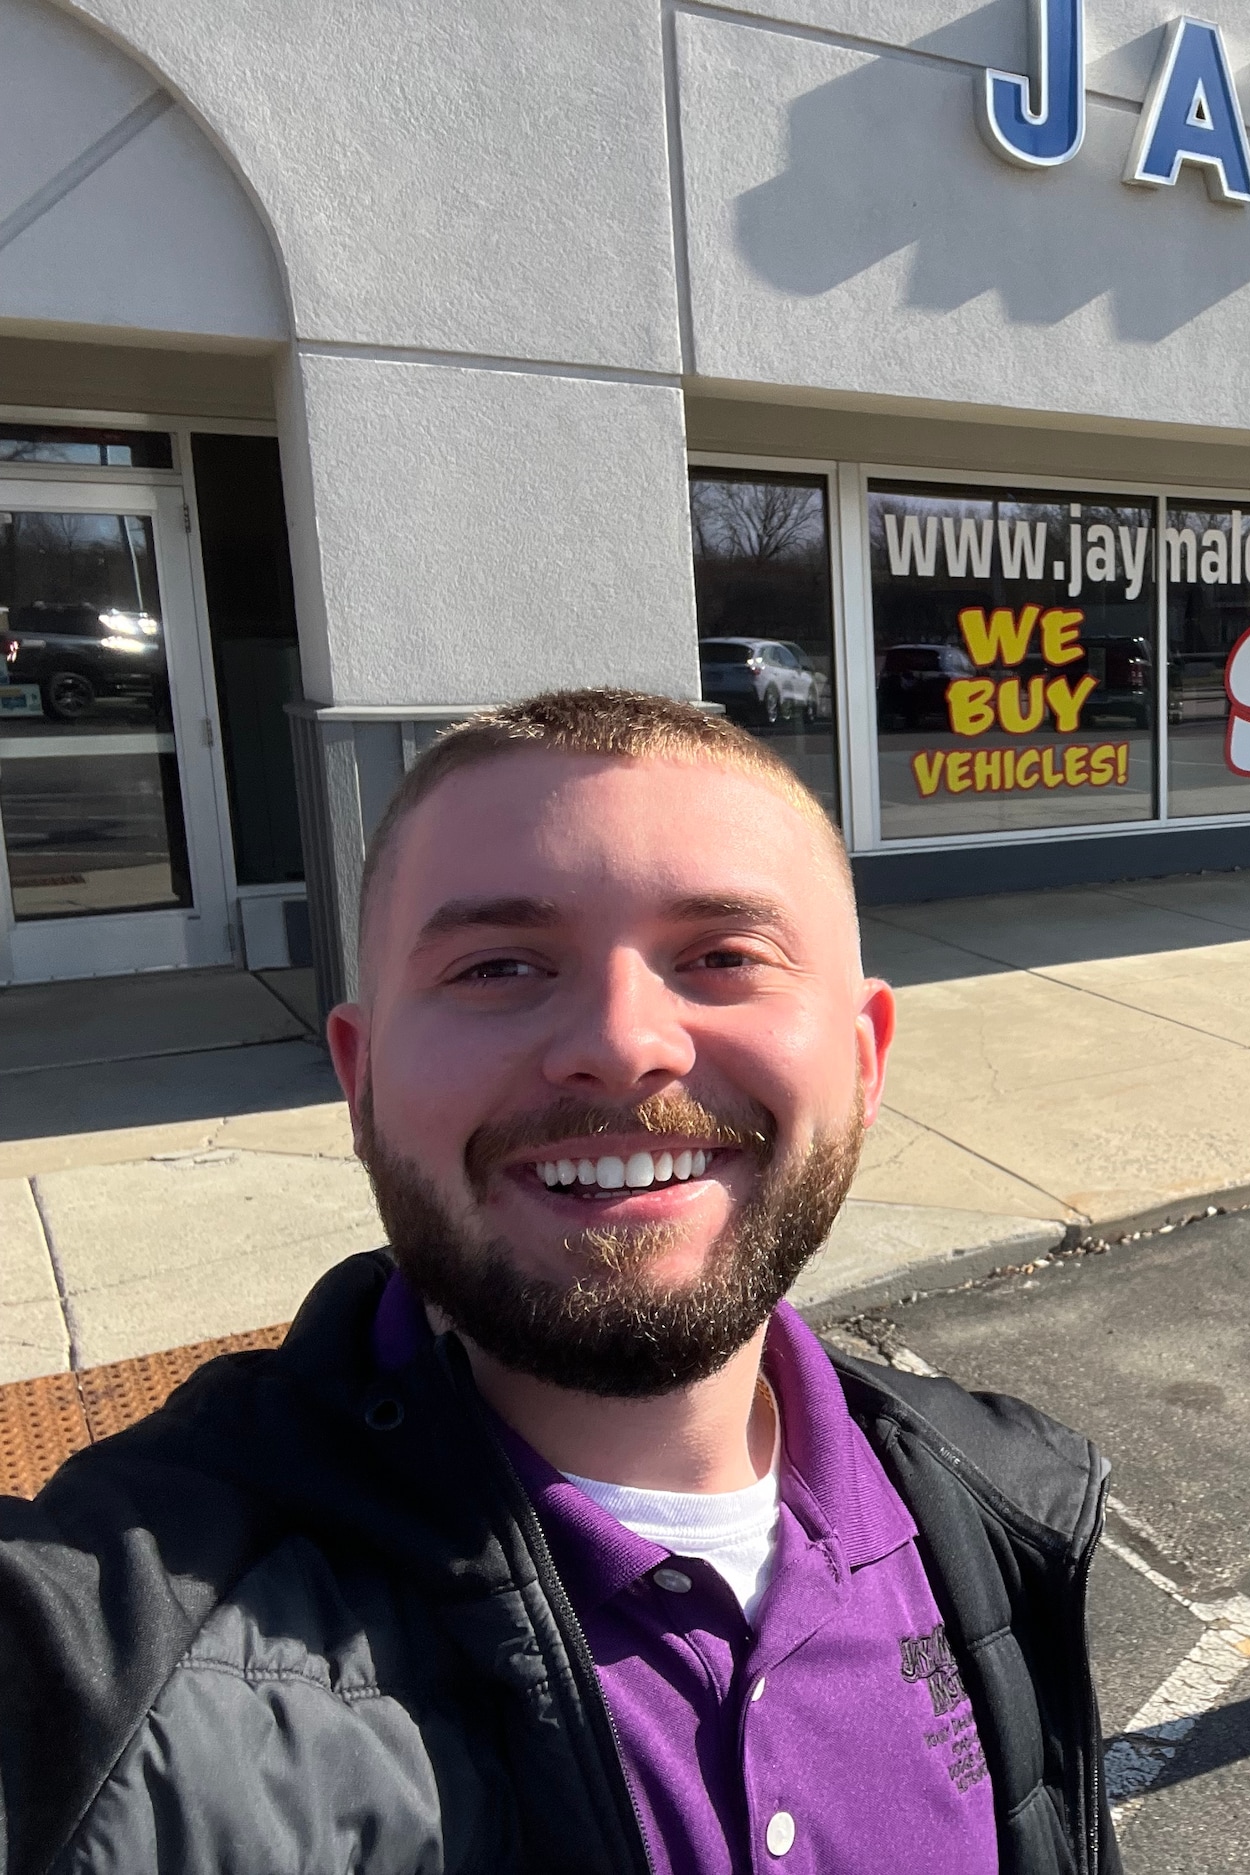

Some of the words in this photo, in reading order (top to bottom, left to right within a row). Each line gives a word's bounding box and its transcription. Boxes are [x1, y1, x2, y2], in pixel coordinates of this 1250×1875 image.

[957, 602, 1086, 668] WE
[946, 674, 1099, 737] BUY
[912, 741, 1130, 797] VEHICLES!
[940, 1446, 961, 1467] NIKE
